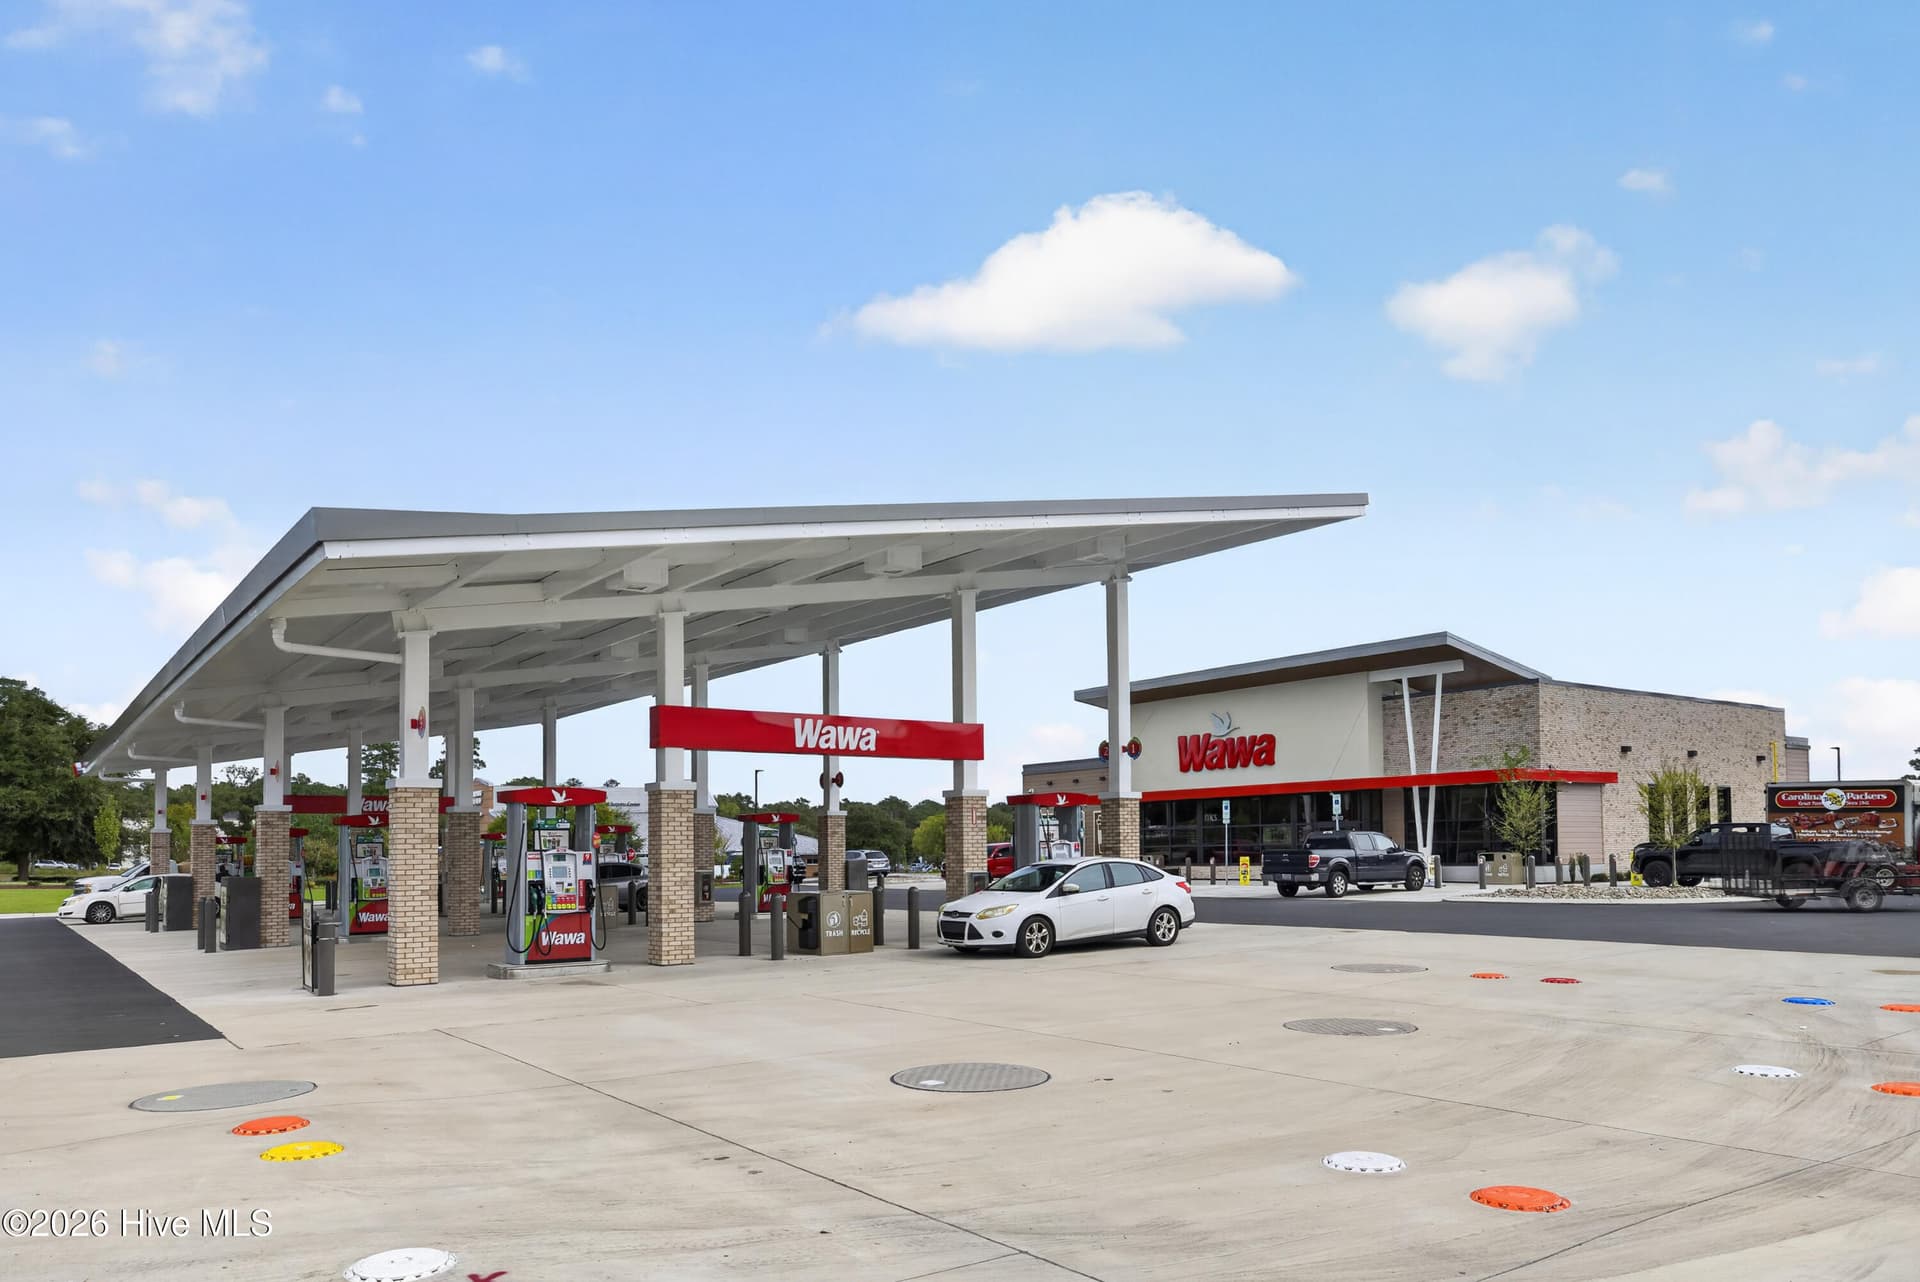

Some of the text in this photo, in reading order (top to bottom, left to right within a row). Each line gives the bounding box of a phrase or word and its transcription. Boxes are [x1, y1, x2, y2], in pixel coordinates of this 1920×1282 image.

[794, 718, 876, 751] Wawa
[1178, 732, 1276, 773] Wawa
[1846, 791, 1887, 800] Packers
[541, 931, 586, 946] Wawa
[851, 928, 871, 936] RECYCLE
